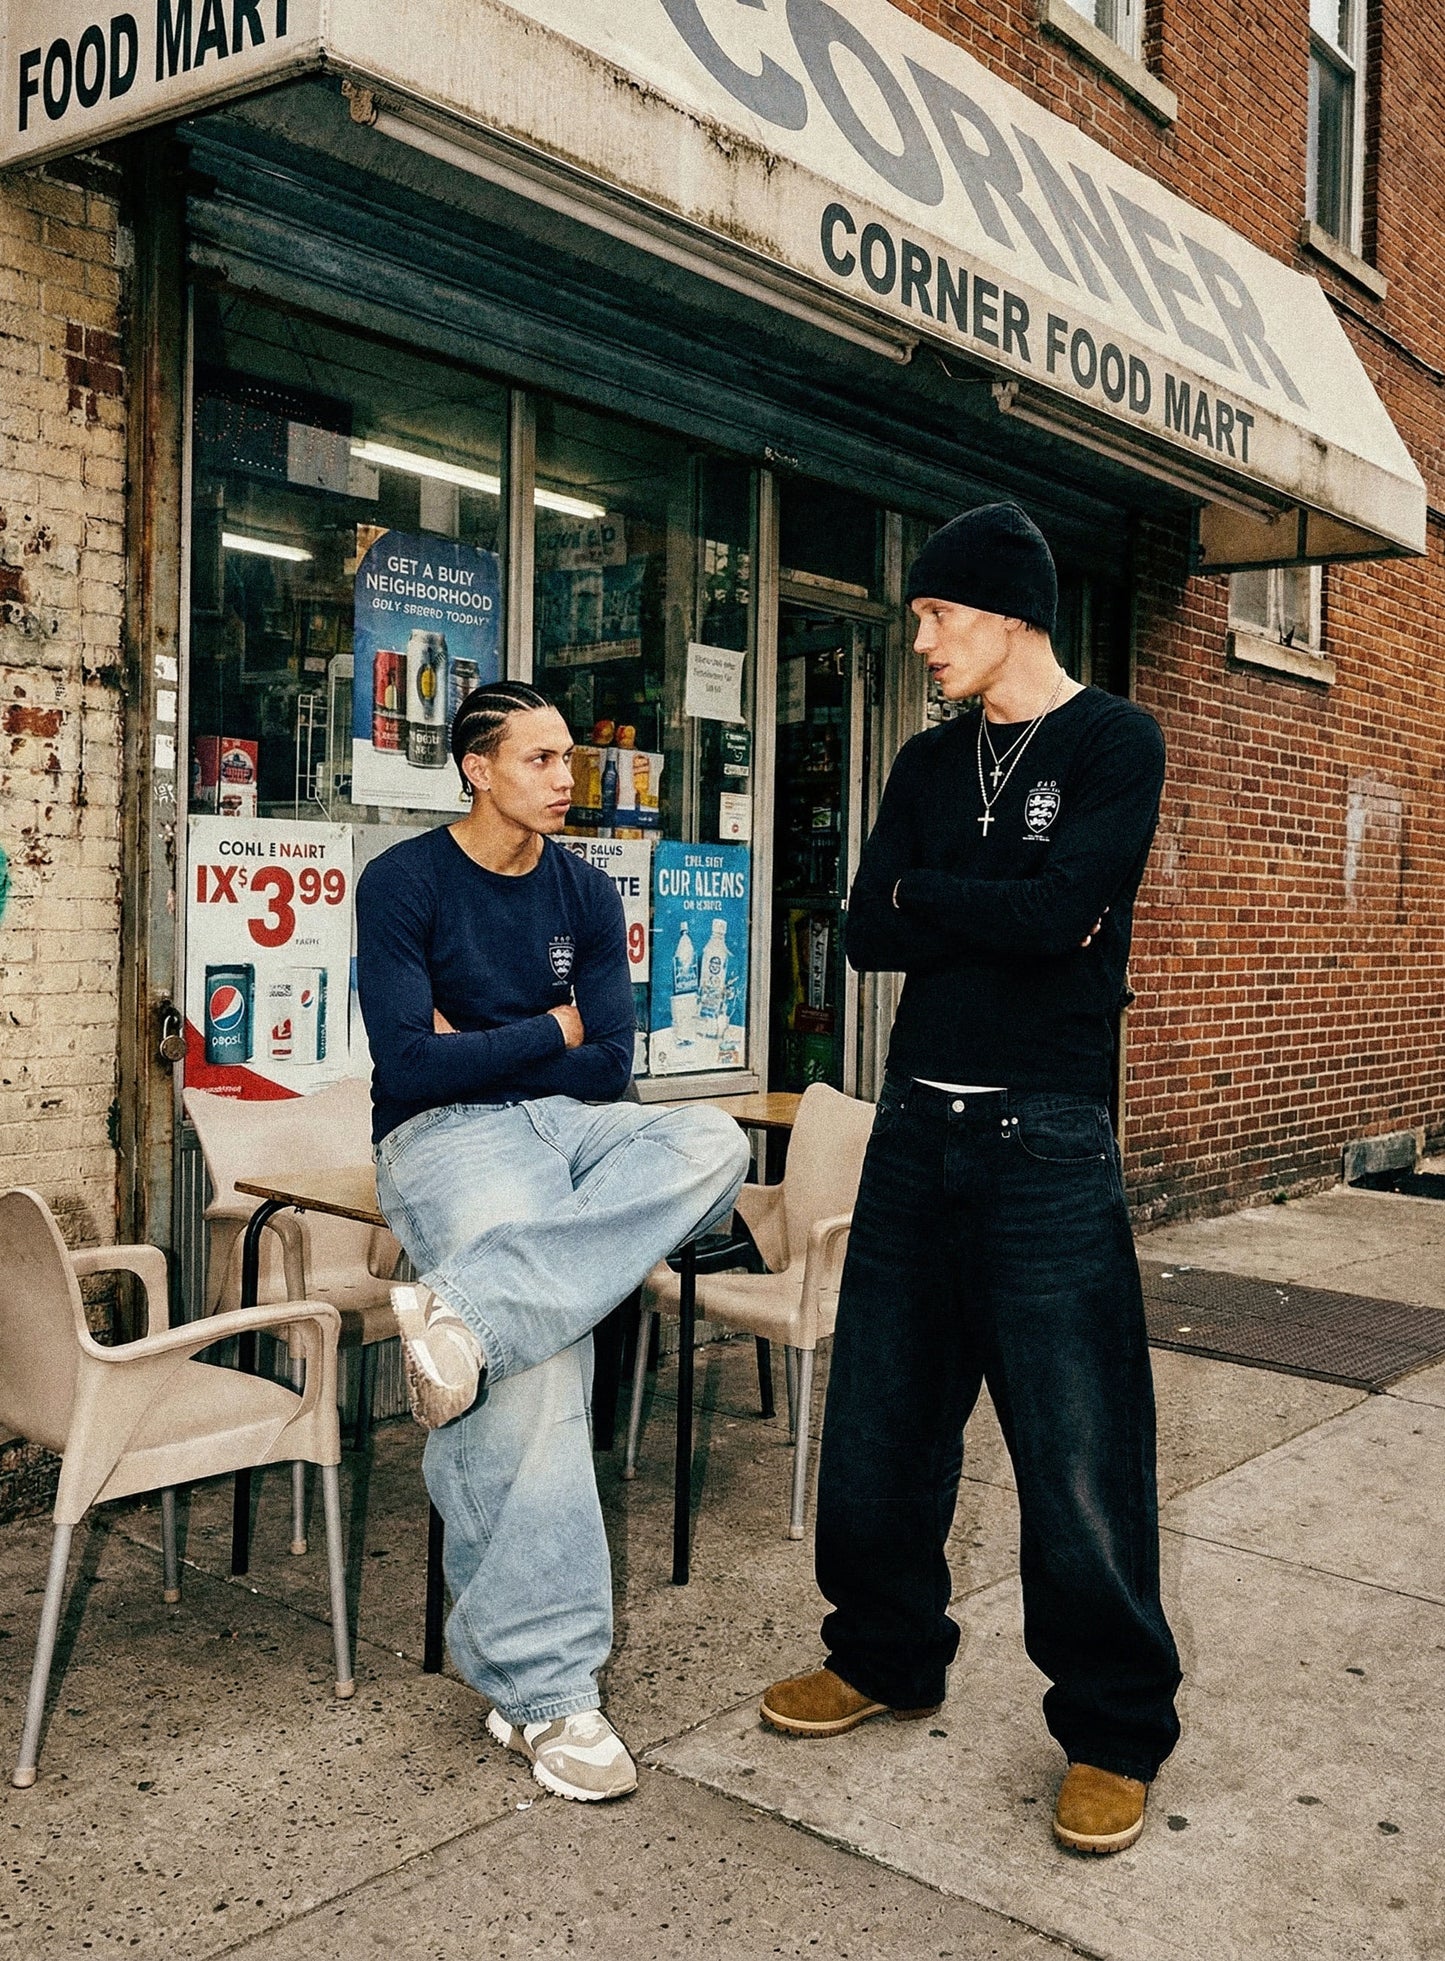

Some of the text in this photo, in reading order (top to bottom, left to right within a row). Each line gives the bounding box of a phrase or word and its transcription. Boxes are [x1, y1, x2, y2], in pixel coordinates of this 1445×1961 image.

[19, 13, 138, 132] FOOD
[660, 0, 1310, 410] CORNER
[820, 202, 1255, 463] CORNER FOOD MART
[366, 572, 493, 611] NEIGHBORHOOD
[387, 556, 419, 576] GET
[422, 563, 434, 579] A
[659, 868, 690, 897] CUR
